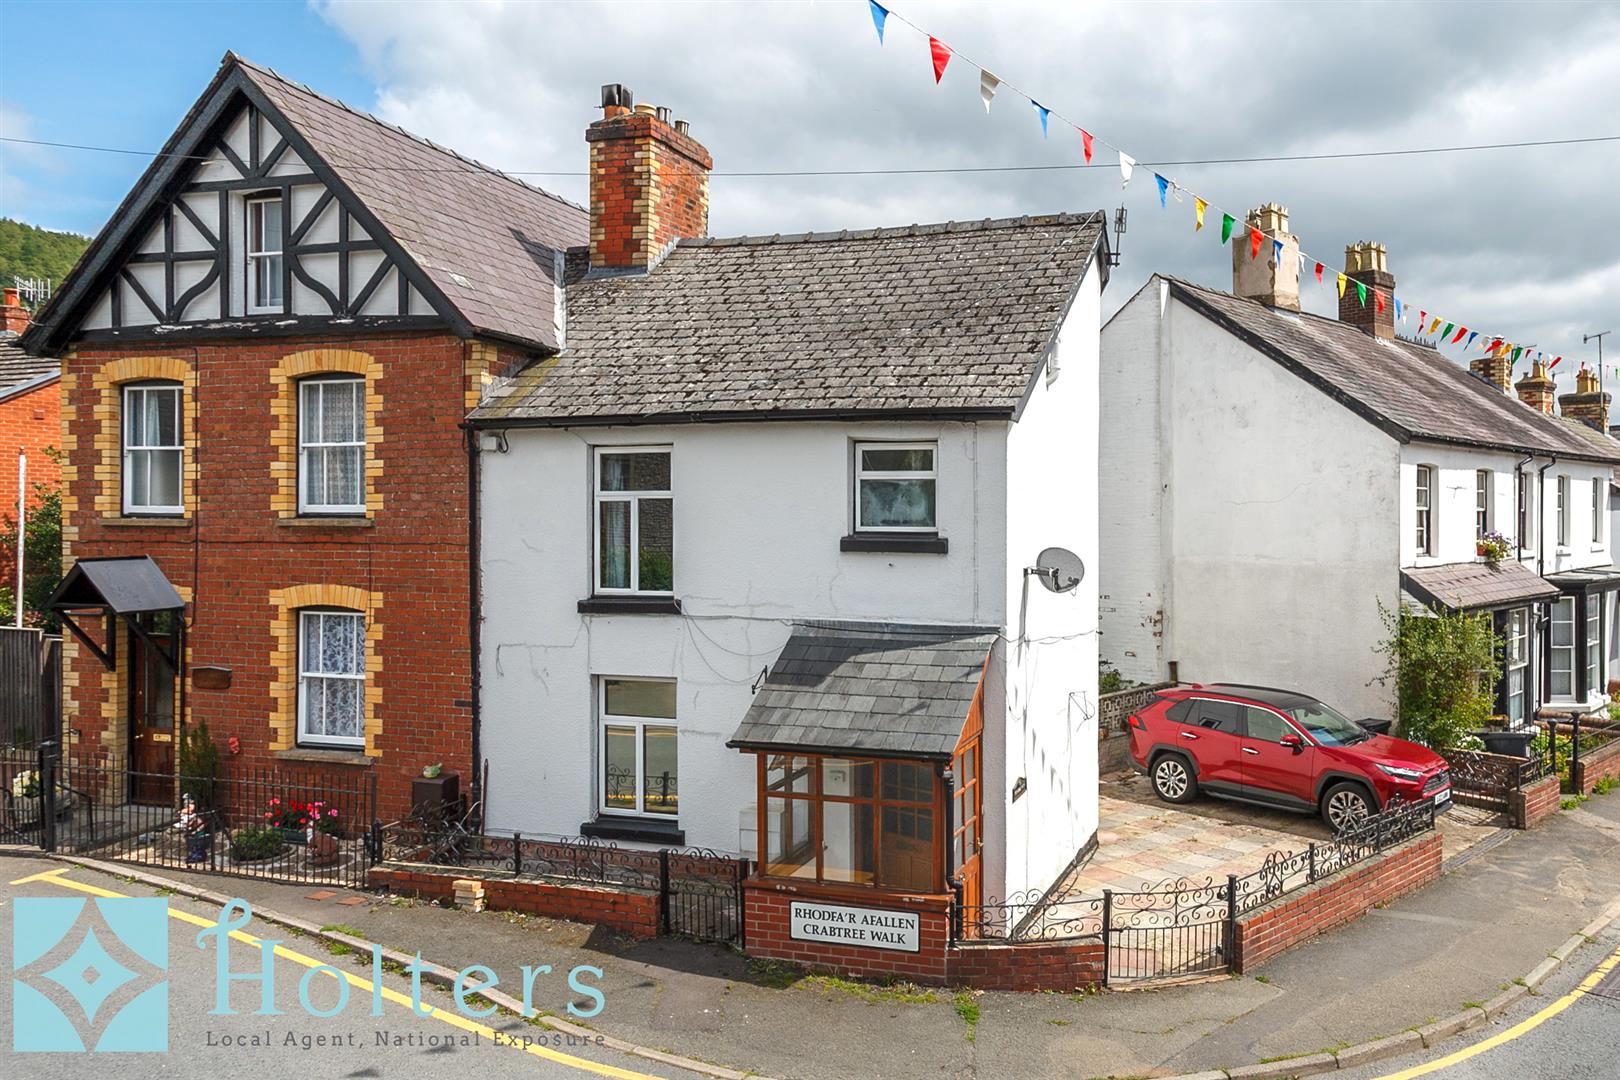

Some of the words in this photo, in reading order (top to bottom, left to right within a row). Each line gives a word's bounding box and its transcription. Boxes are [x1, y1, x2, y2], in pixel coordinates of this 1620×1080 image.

[794, 907, 857, 924] RHODFA'R
[861, 914, 915, 930] AFALLEN
[803, 923, 866, 940] CRABTREE
[870, 930, 906, 944] WALK
